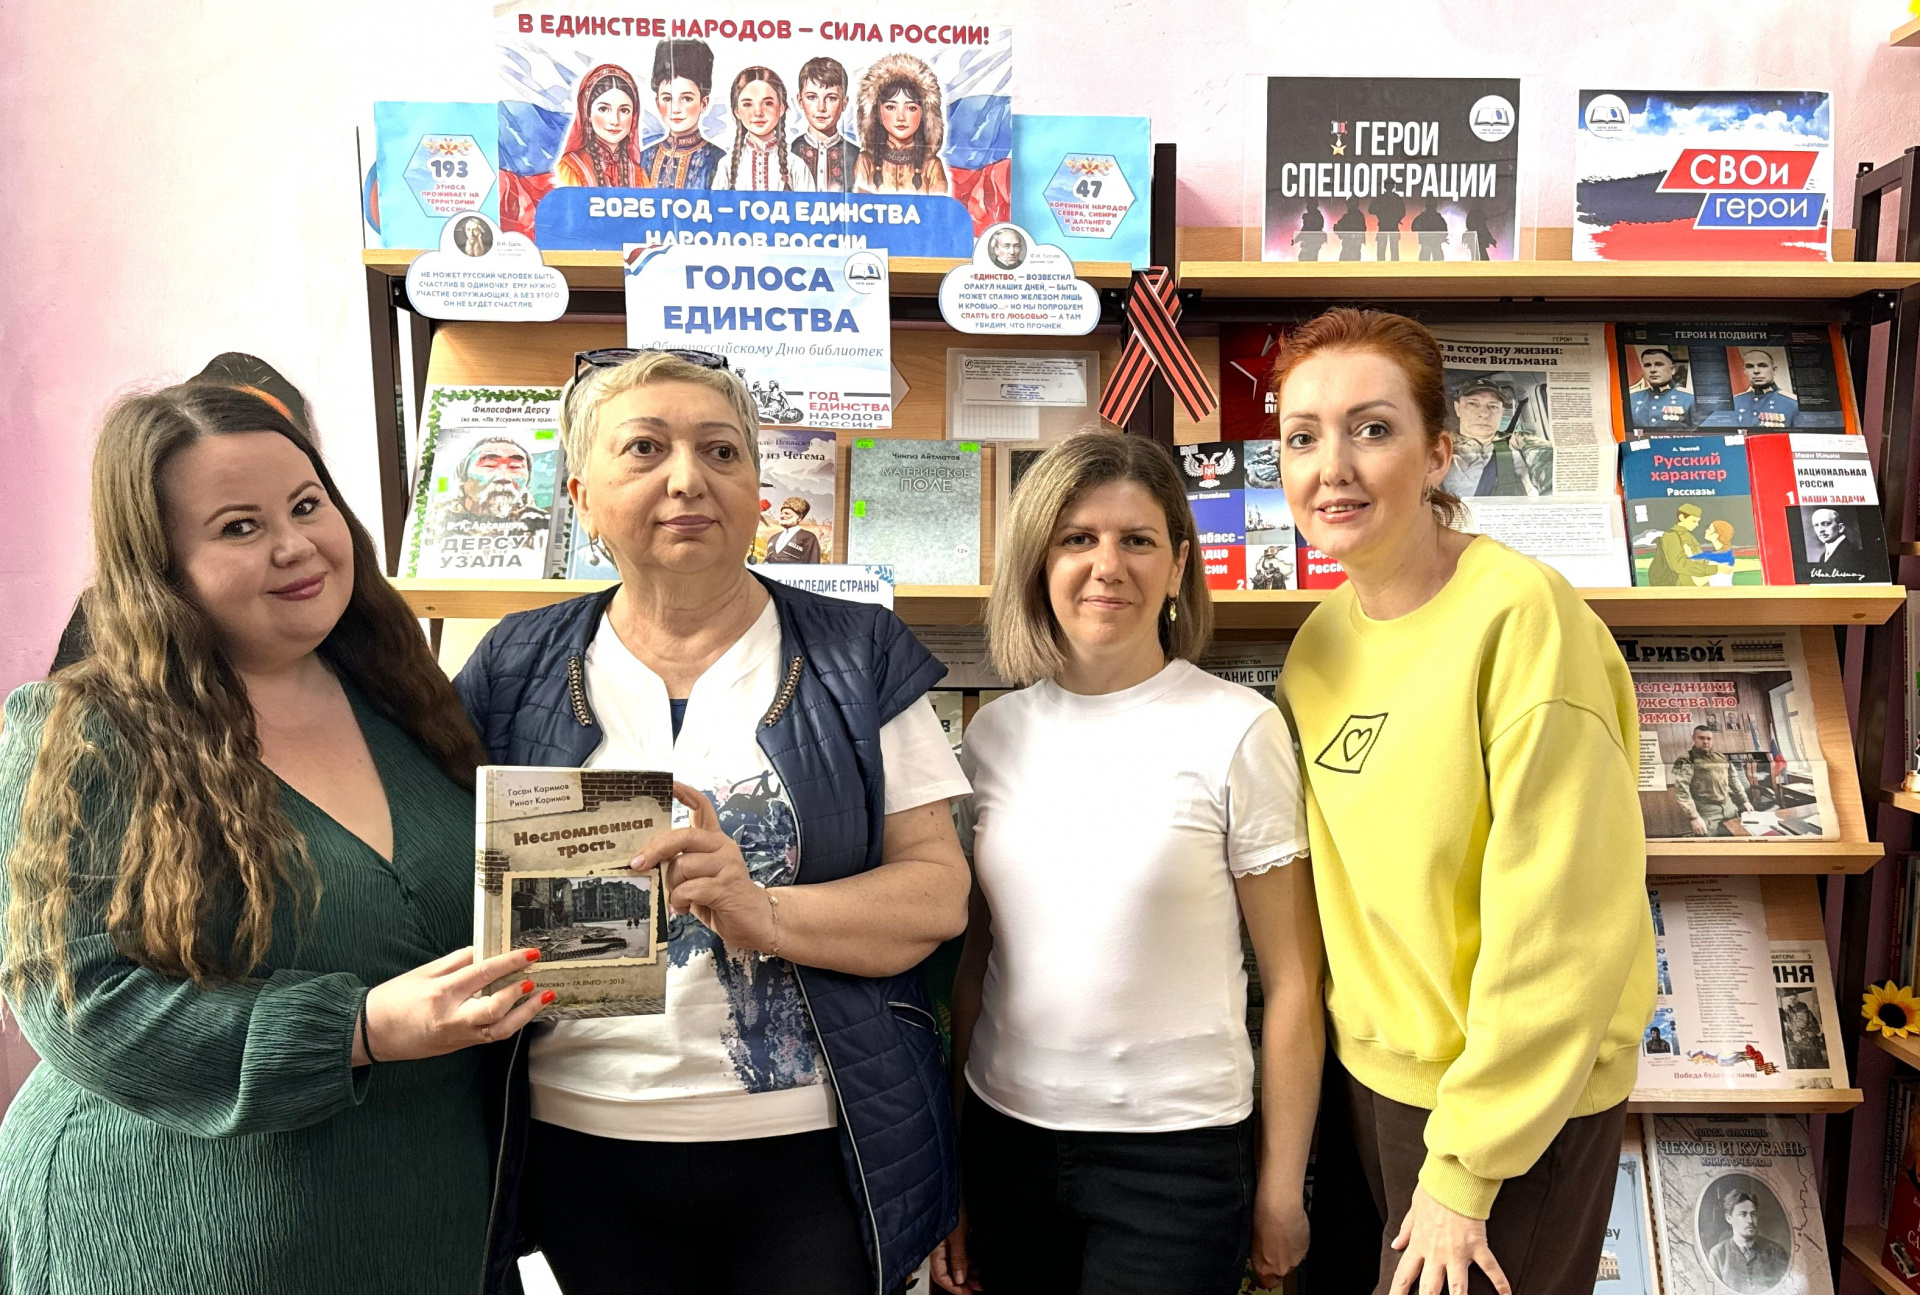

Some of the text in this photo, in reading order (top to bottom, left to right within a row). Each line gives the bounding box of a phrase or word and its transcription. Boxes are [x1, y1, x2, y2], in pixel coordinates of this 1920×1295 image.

[519, 14, 989, 45] В ЕДИНСТВЕ НАРОДОВ СИЛА РОССИИ!
[1355, 121, 1439, 156] ГЕРОИ
[431, 160, 468, 178] 193
[1690, 154, 1789, 186] СВОи
[1281, 163, 1497, 201] СПЕЦОПЕРАЦИИ
[1076, 180, 1102, 198] 47
[589, 197, 921, 225] 2026 ГОД ГОД ЕДИНСТВА
[1092, 204, 1127, 212] НАРОДОВ
[1715, 197, 1808, 225] герои
[462, 270, 495, 279] РУССКИЙ
[497, 272, 532, 280] ЧЕЛОВЕК
[685, 265, 835, 292] ГОЛОСА
[663, 306, 860, 334] ЕДИНСТВА
[1674, 330, 1767, 341] ГЕРОИ И ПОДВИГИ
[776, 342, 806, 356] Дню
[809, 345, 883, 357] библиотек
[1457, 344, 1512, 357] сторону
[1514, 346, 1563, 355] жизни:
[1443, 354, 1558, 365] лексея Вильмана
[809, 391, 839, 402] ГОД
[472, 406, 550, 414] Философия Дерсу
[809, 402, 890, 412] ЕДИНСТВА
[809, 413, 883, 421] НАРОДОВ
[783, 450, 825, 461] Чегема
[920, 452, 960, 460] Айтматов
[1654, 452, 1721, 470] Русский
[882, 467, 970, 478] МАТЕРИНСКОЕ
[1651, 468, 1727, 483] характер
[1797, 468, 1867, 477] НАЦИОНАЛЬНАЯ
[900, 478, 952, 492] ПОЛЕ
[1799, 480, 1835, 488] РОССИЯ
[1666, 487, 1716, 497] Рассказы
[1786, 490, 1796, 505] 1
[1801, 495, 1866, 504] НАШИ ЗАДАЧИ
[1199, 532, 1236, 544] нбасс
[440, 537, 526, 553] ДЕРСУ
[1202, 549, 1229, 560] дце
[440, 554, 523, 568] УЗАЛА
[1205, 564, 1228, 575] сии
[840, 579, 879, 593] СТРАНЫ
[1237, 579, 1245, 590] 2
[1634, 681, 1734, 695] аследники
[1637, 697, 1737, 709] ужества по
[534, 784, 570, 794] Каримов
[510, 795, 571, 807] Ринат Каримов
[513, 817, 654, 846] Несломленная
[557, 840, 616, 859] трость
[1674, 1072, 1702, 1080] Победа
[1695, 1128, 1725, 1137] ОЛЬГА
[1658, 1140, 1807, 1156] ЧЕХОВ И КУБАНЬ
[1701, 1157, 1772, 1167] КНИГА ОЧЕРКОВ
